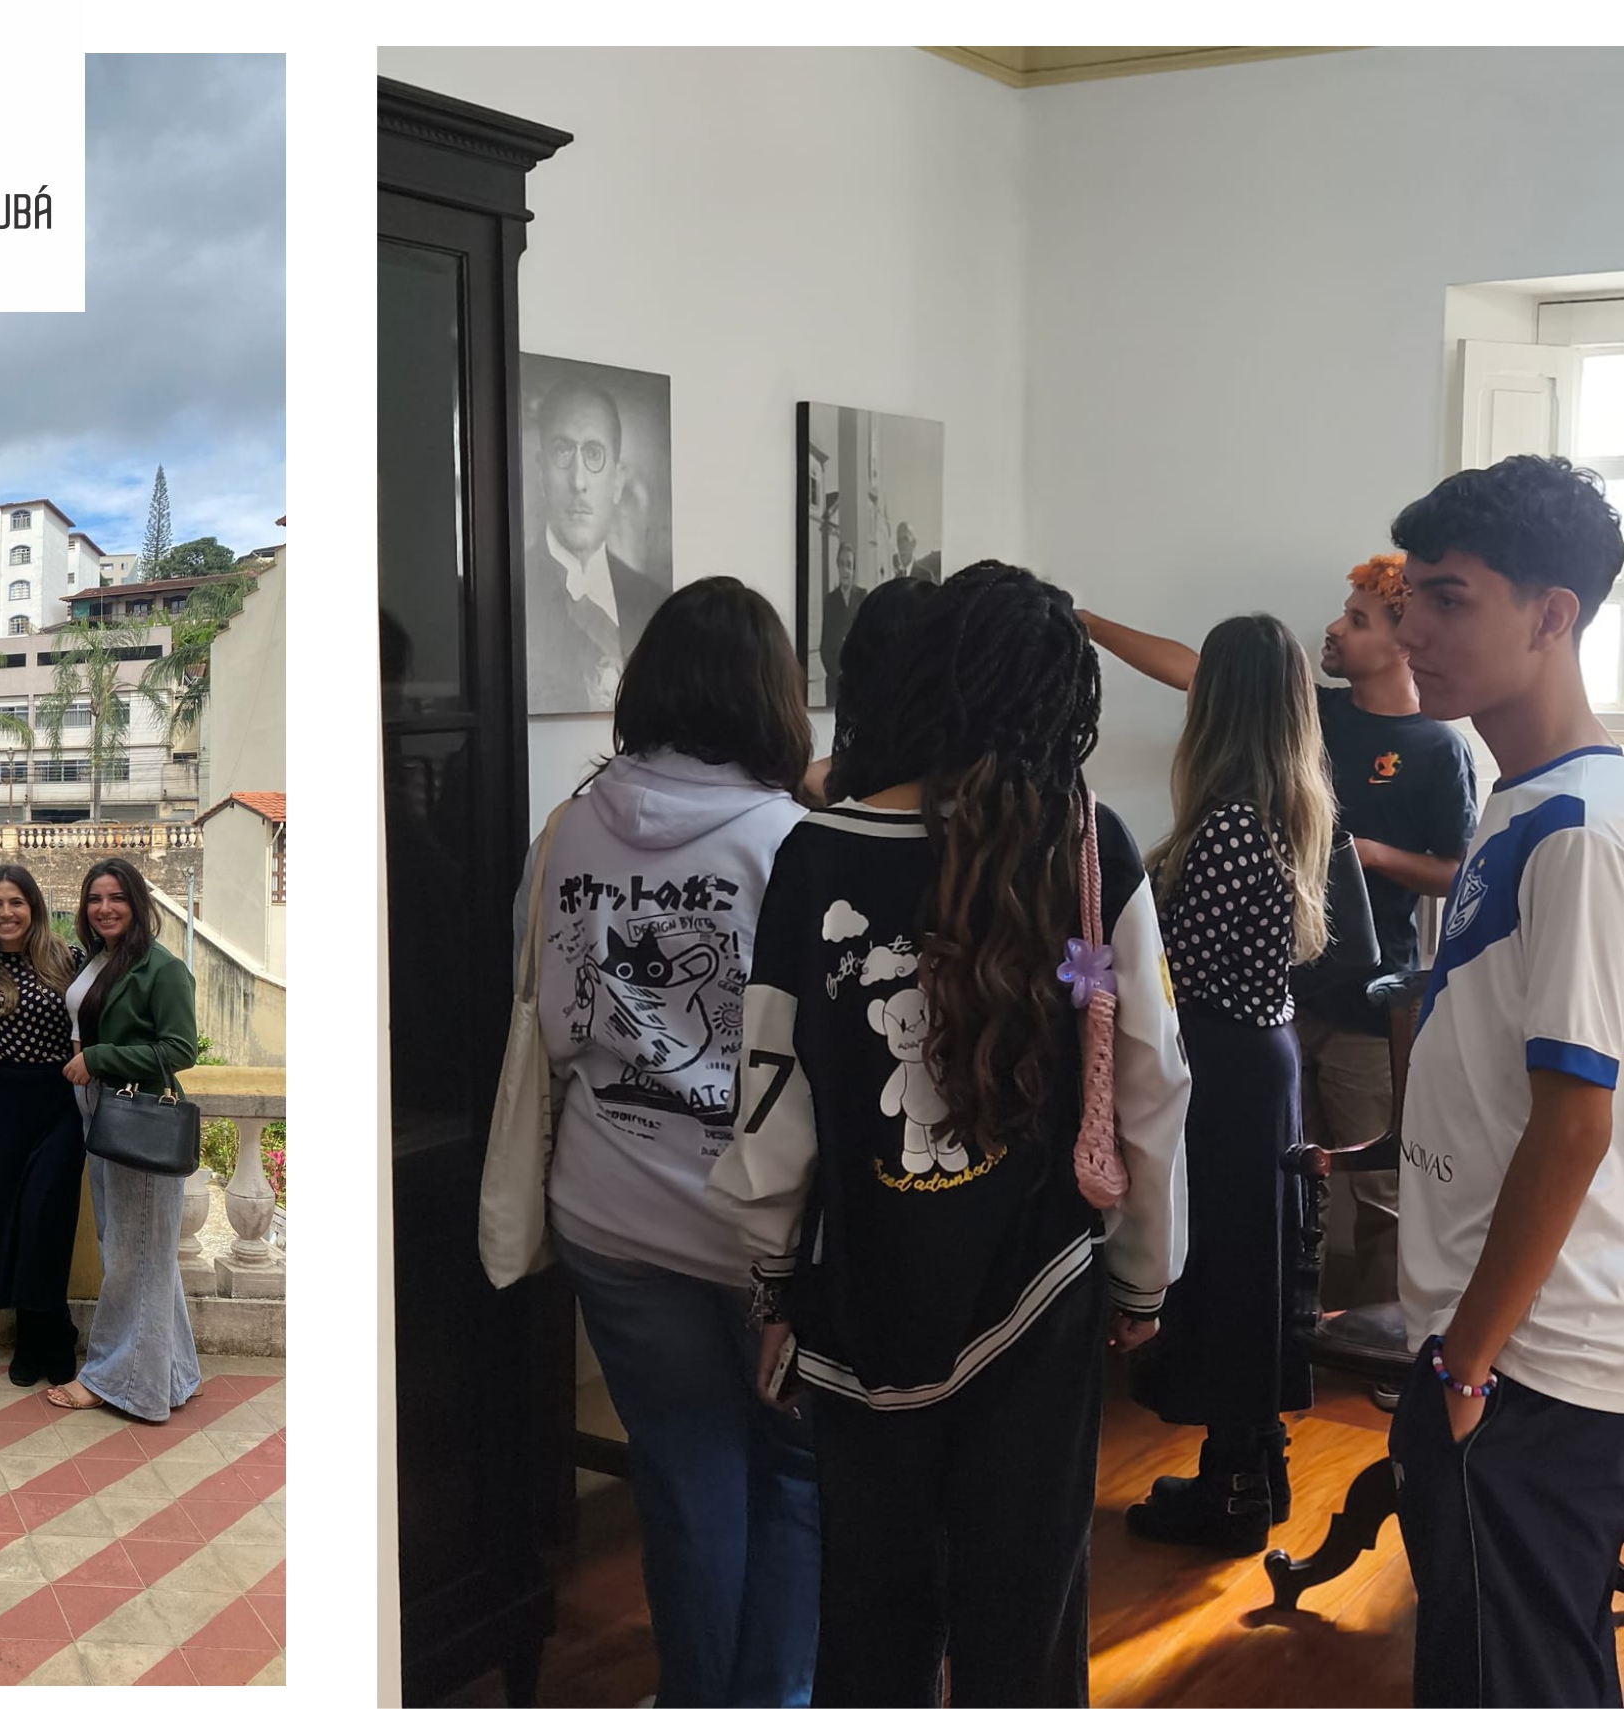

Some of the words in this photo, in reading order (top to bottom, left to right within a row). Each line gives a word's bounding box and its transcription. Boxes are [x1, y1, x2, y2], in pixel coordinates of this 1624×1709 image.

[559, 873, 739, 915] ポケットのねこ
[632, 919, 676, 937] DESIGN
[679, 917, 695, 929] BY
[744, 1049, 796, 1134] 7
